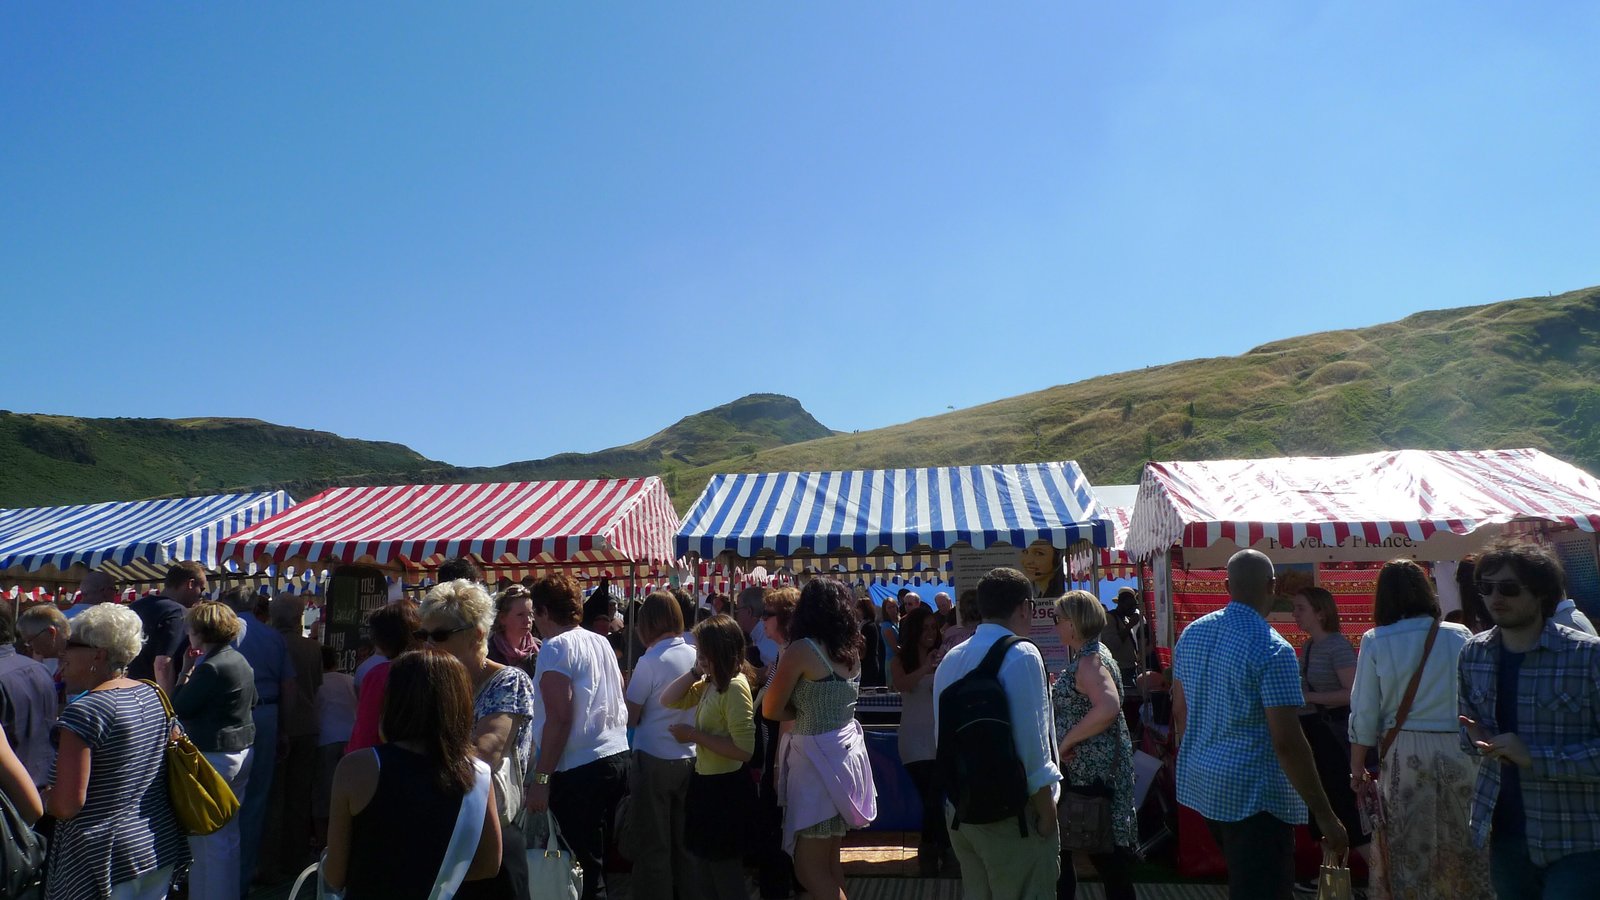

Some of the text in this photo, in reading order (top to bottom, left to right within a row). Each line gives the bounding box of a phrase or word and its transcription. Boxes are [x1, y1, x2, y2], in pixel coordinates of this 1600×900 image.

[1269, 536, 1345, 549] Pvene
[361, 577, 376, 593] my
[330, 631, 346, 651] my
[336, 648, 357, 671] ad's
